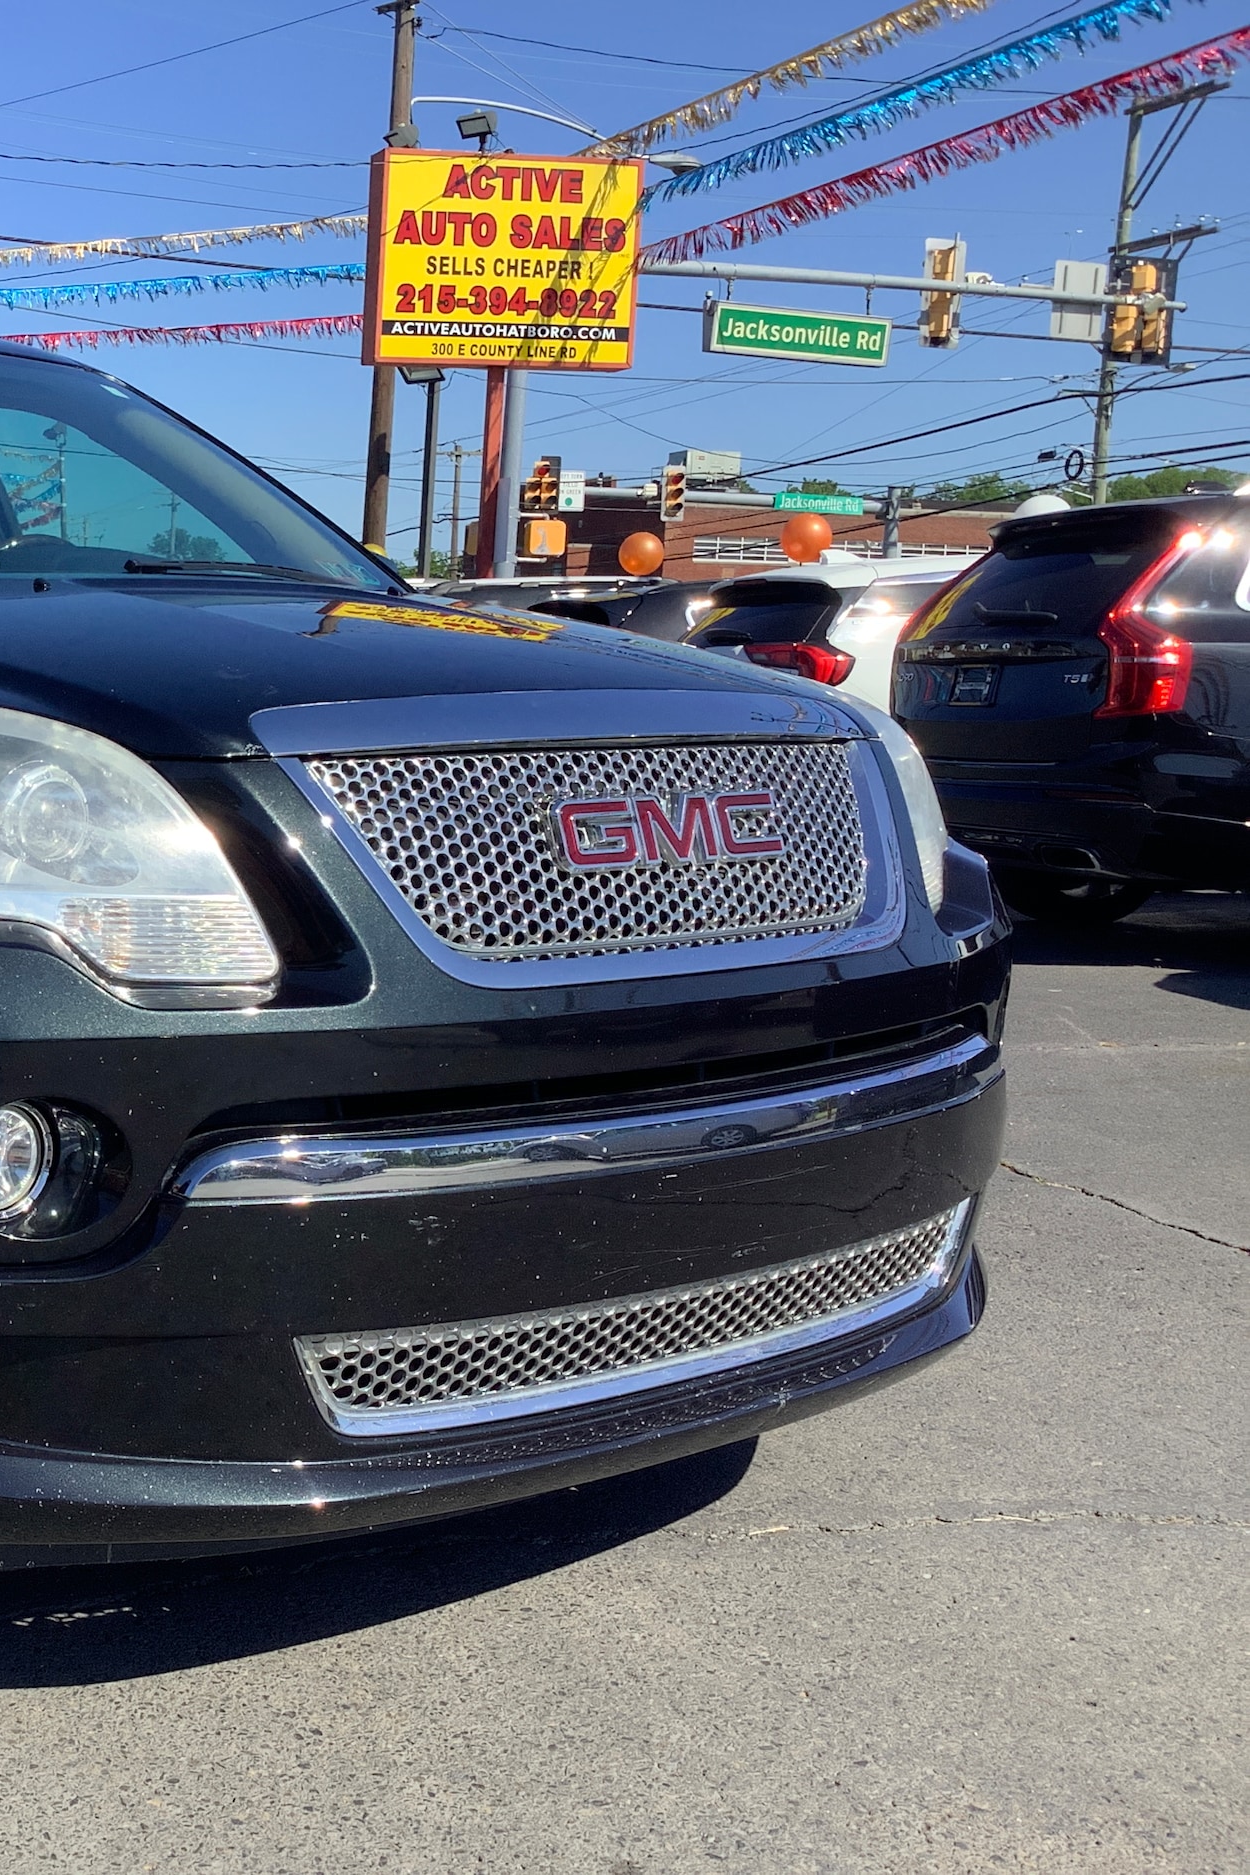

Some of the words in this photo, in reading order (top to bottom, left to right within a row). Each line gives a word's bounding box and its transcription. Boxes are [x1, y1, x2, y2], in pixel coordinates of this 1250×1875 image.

[443, 164, 583, 204] ACTIVE
[393, 210, 497, 248] AUTO
[510, 214, 627, 253] SALES
[426, 255, 485, 276] SELLS
[493, 258, 582, 279] CHEAPER
[395, 283, 617, 319] 215-394-8922
[391, 322, 616, 340] ACTIVEAUTOHATBORO.COM
[722, 317, 850, 349] Jacksonville
[856, 331, 881, 351] Rd
[431, 343, 453, 355] 300
[458, 344, 465, 356] E
[470, 344, 523, 358] COUNTY
[527, 345, 556, 358] LINE
[560, 347, 577, 359] RD
[779, 495, 842, 512] Jacksonville
[845, 499, 859, 512] Rd
[557, 790, 785, 870] GMC
